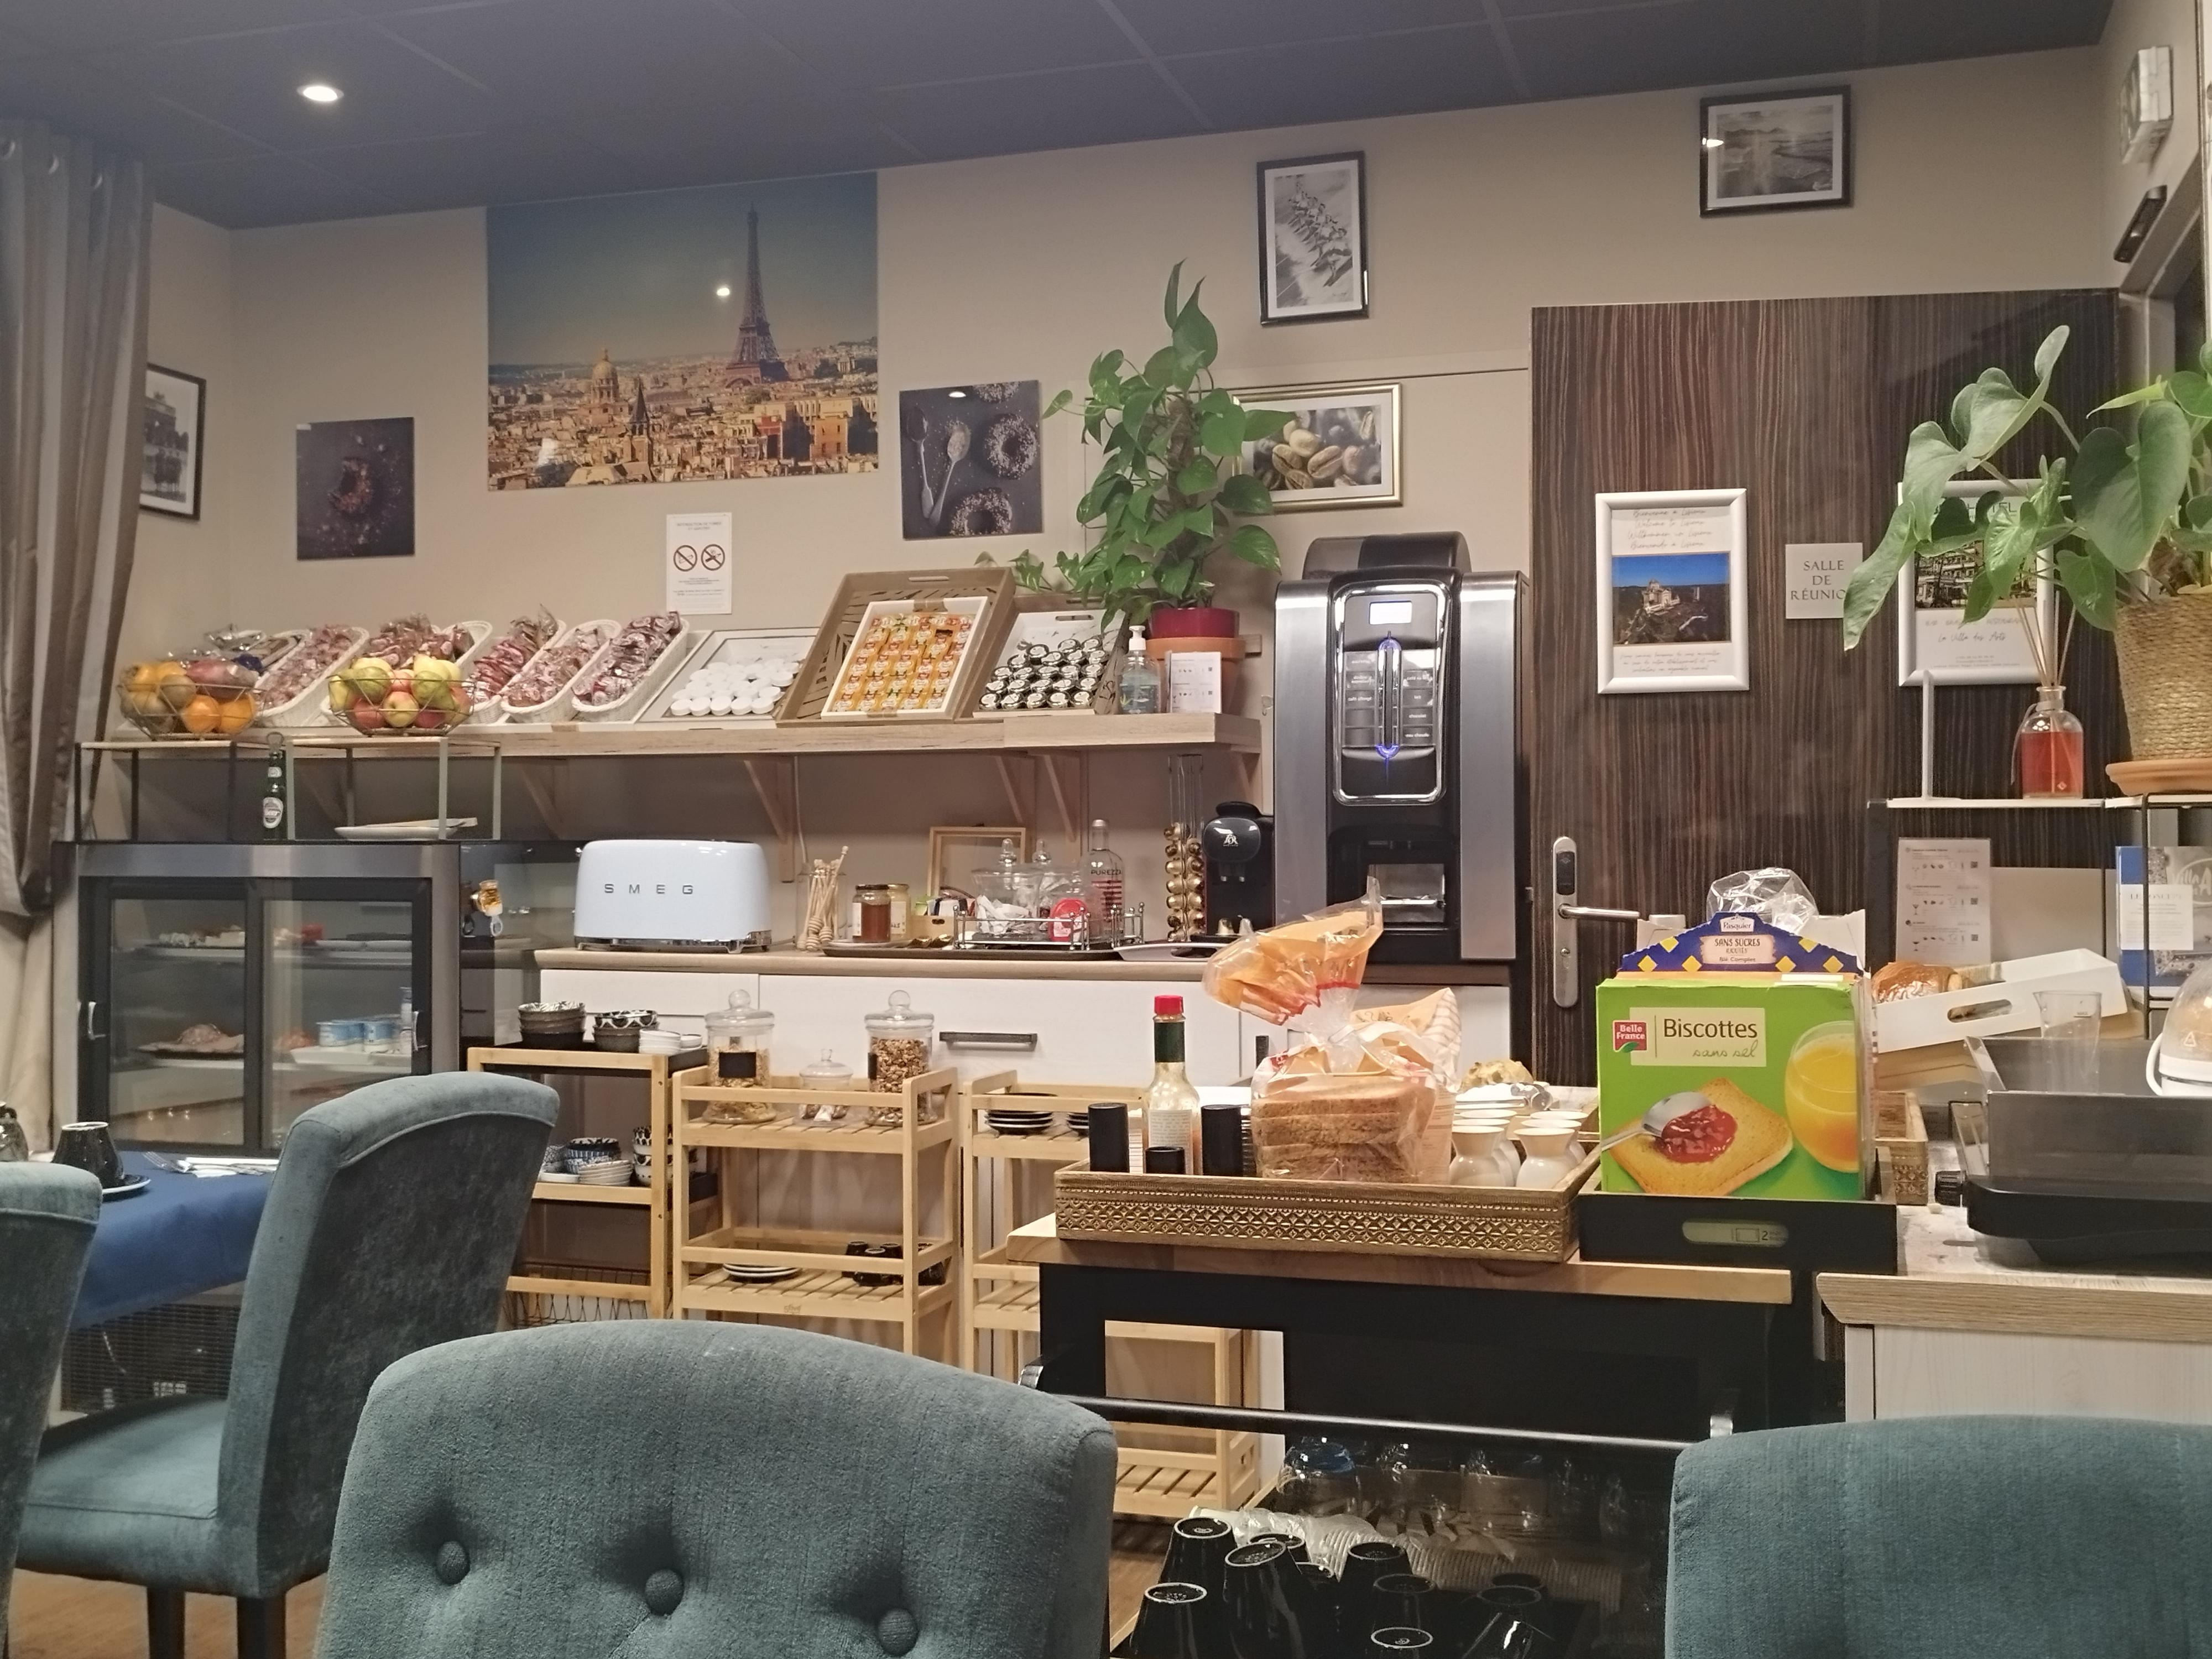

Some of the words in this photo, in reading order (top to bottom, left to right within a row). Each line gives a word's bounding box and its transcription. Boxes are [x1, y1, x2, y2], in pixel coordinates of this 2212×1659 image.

[1803, 560, 1845, 571] SALLE
[1812, 575, 1832, 586] DE
[1791, 587, 1847, 601] RÉUNIO
[604, 883, 694, 895] SMEG
[1723, 922, 1751, 930] Pasquier
[1715, 938, 1733, 947] SANS
[1735, 938, 1761, 947] SUCRES
[1619, 1024, 1643, 1033] Belle
[1663, 1018, 1758, 1039] Biscottes
[1616, 1032, 1646, 1040] France
[1692, 1047, 1728, 1057] sans
[1732, 1040, 1759, 1057] sel
